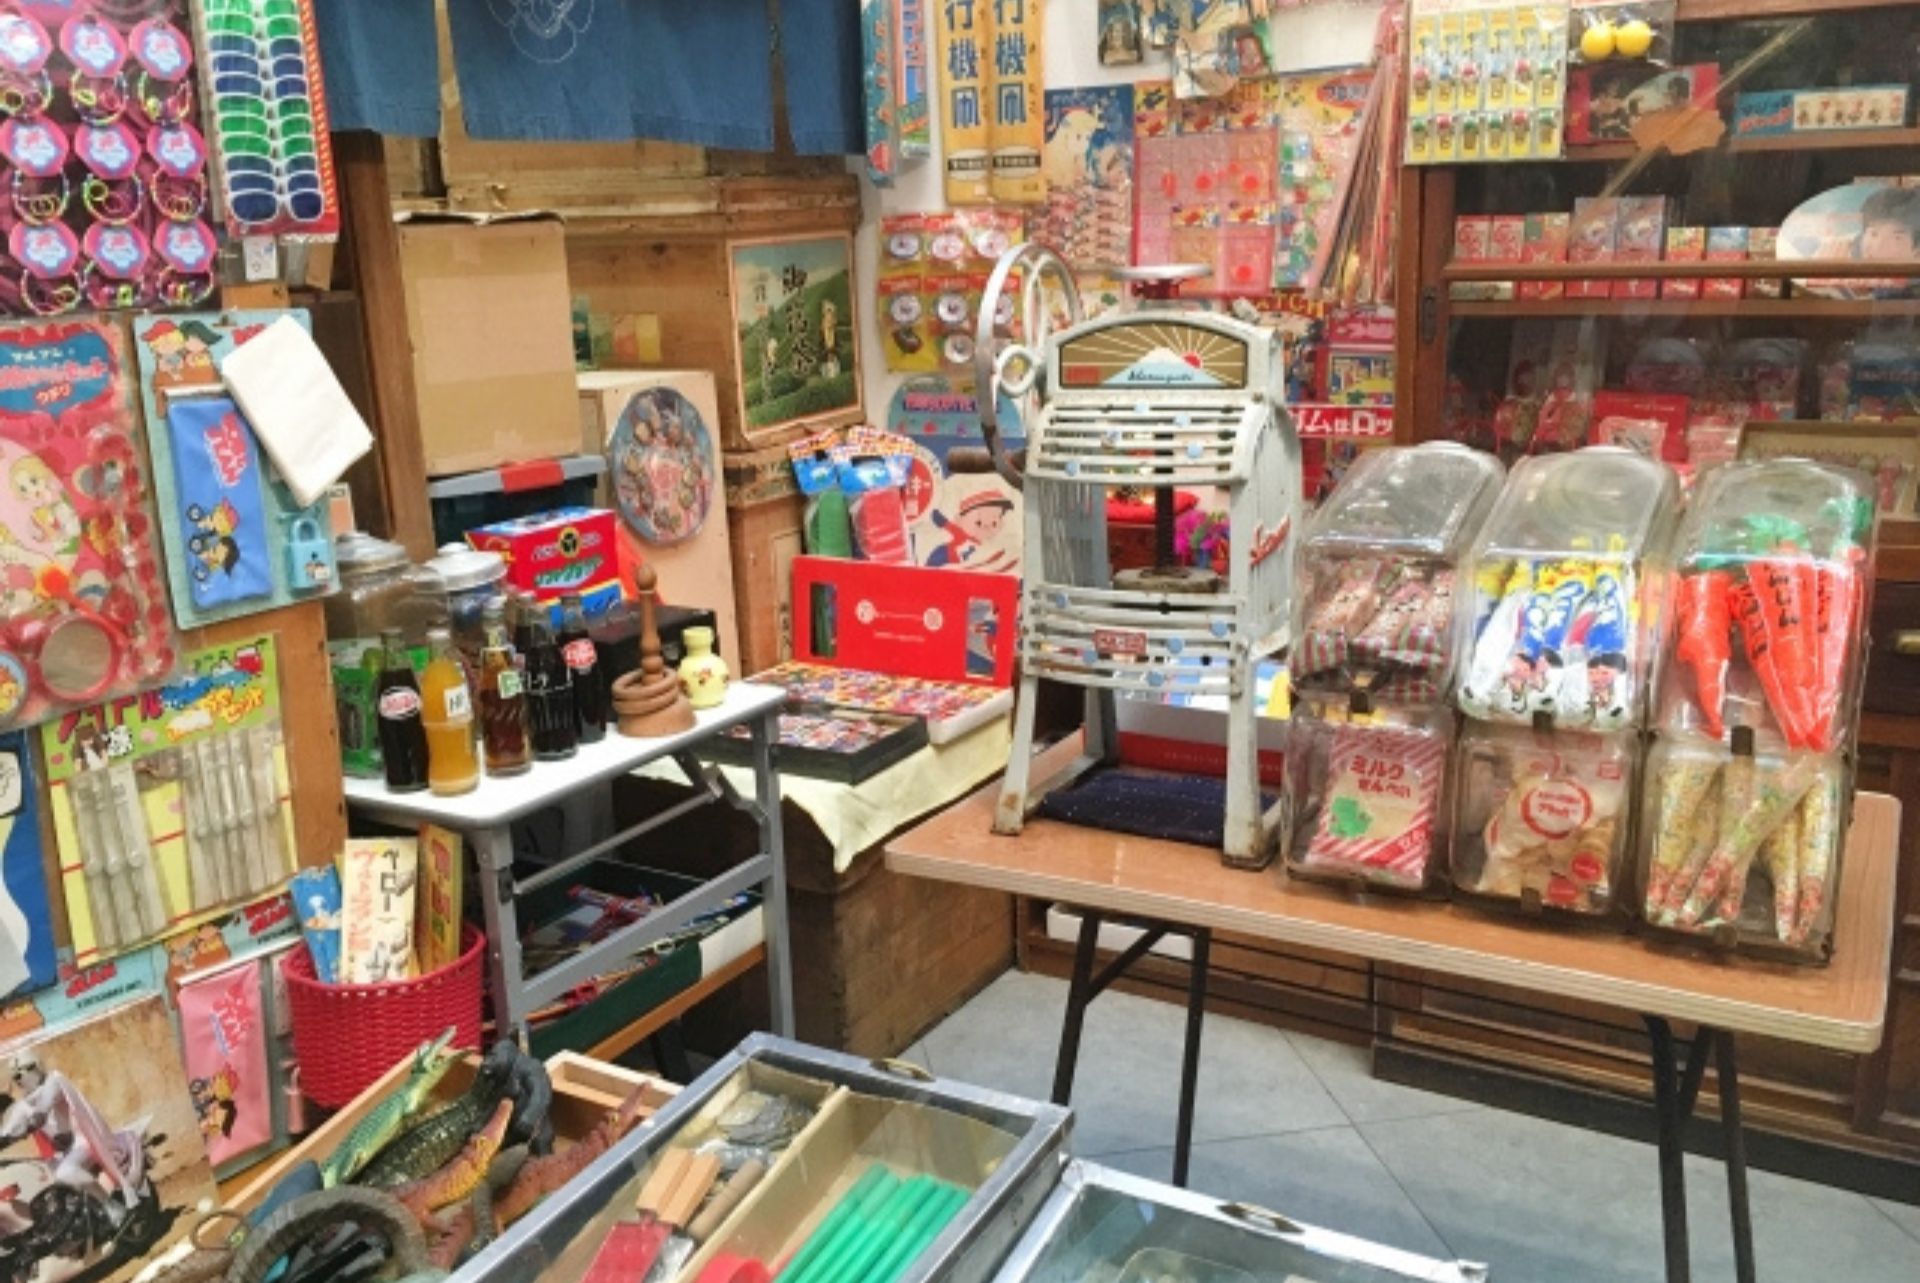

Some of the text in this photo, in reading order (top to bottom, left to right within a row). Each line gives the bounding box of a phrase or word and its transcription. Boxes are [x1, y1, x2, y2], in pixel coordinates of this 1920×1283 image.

[1351, 755, 1404, 779] ミルク
[1358, 779, 1411, 799] せんべい
